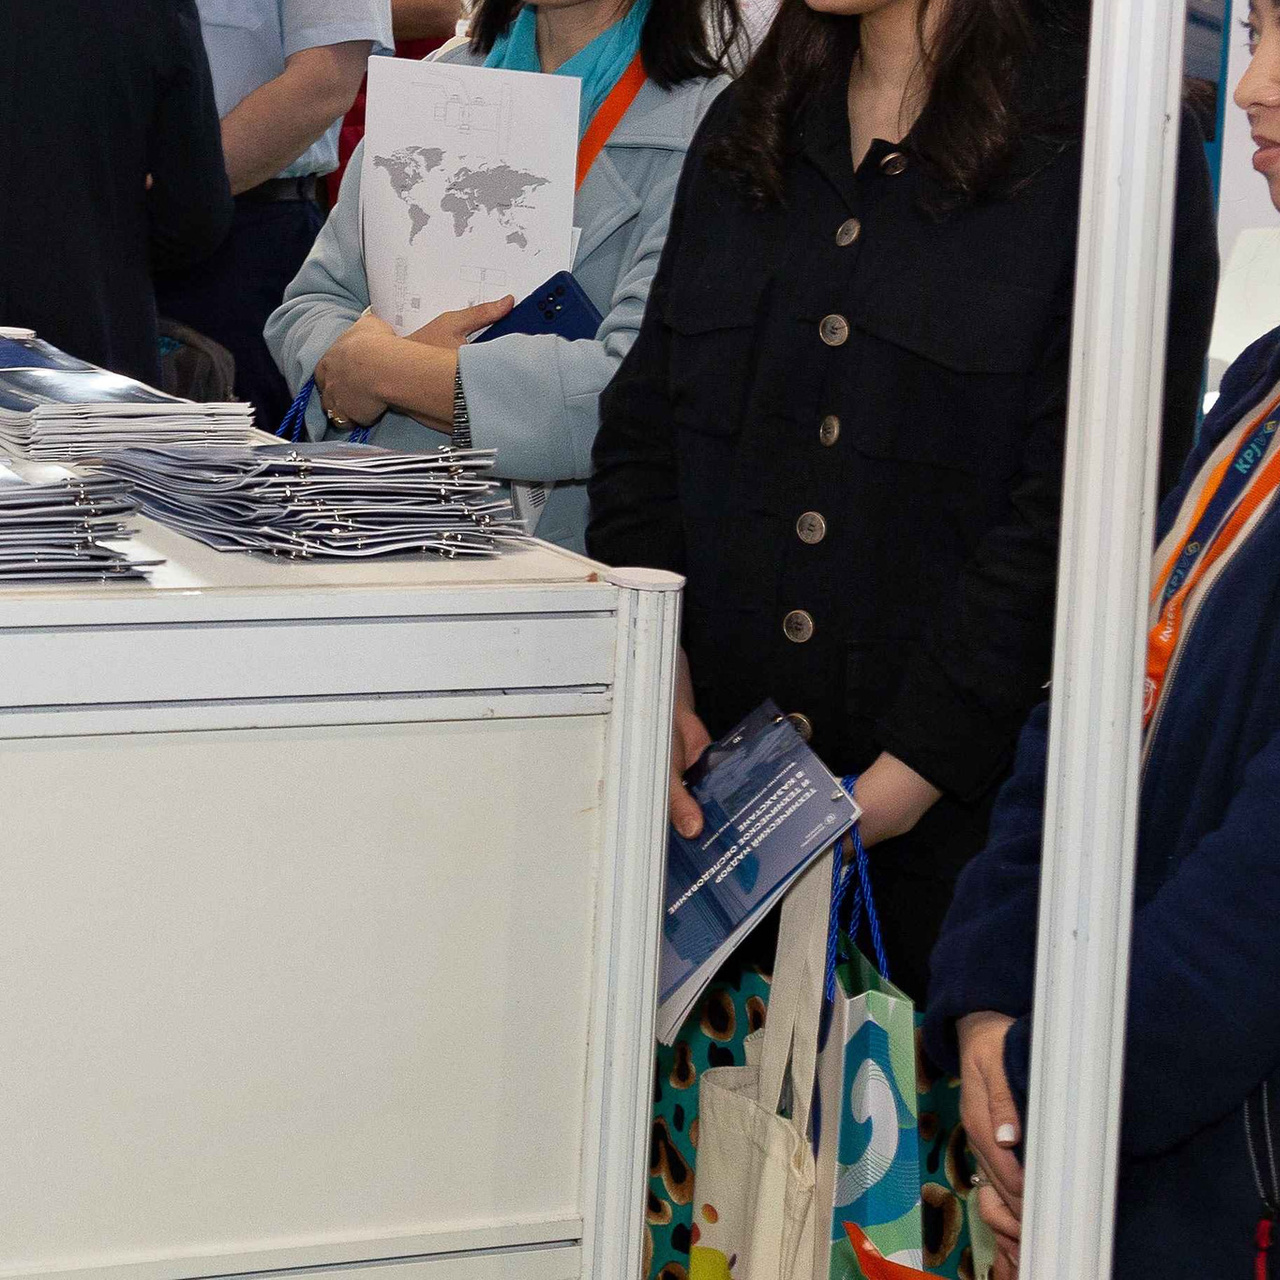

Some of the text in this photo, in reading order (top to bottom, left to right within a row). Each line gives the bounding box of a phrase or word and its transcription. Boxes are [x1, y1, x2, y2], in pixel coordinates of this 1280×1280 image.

[735, 777, 796, 832] КАЗАХСТАНЕ
[736, 786, 802, 846] ТЕХНИЧЕСКОЕ
[749, 786, 817, 847] ТЕХНИЧЕСКИЙ
[668, 844, 737, 915] ОБСЛЕДОВАНИЕ
[714, 845, 753, 884] НАДЗОР
